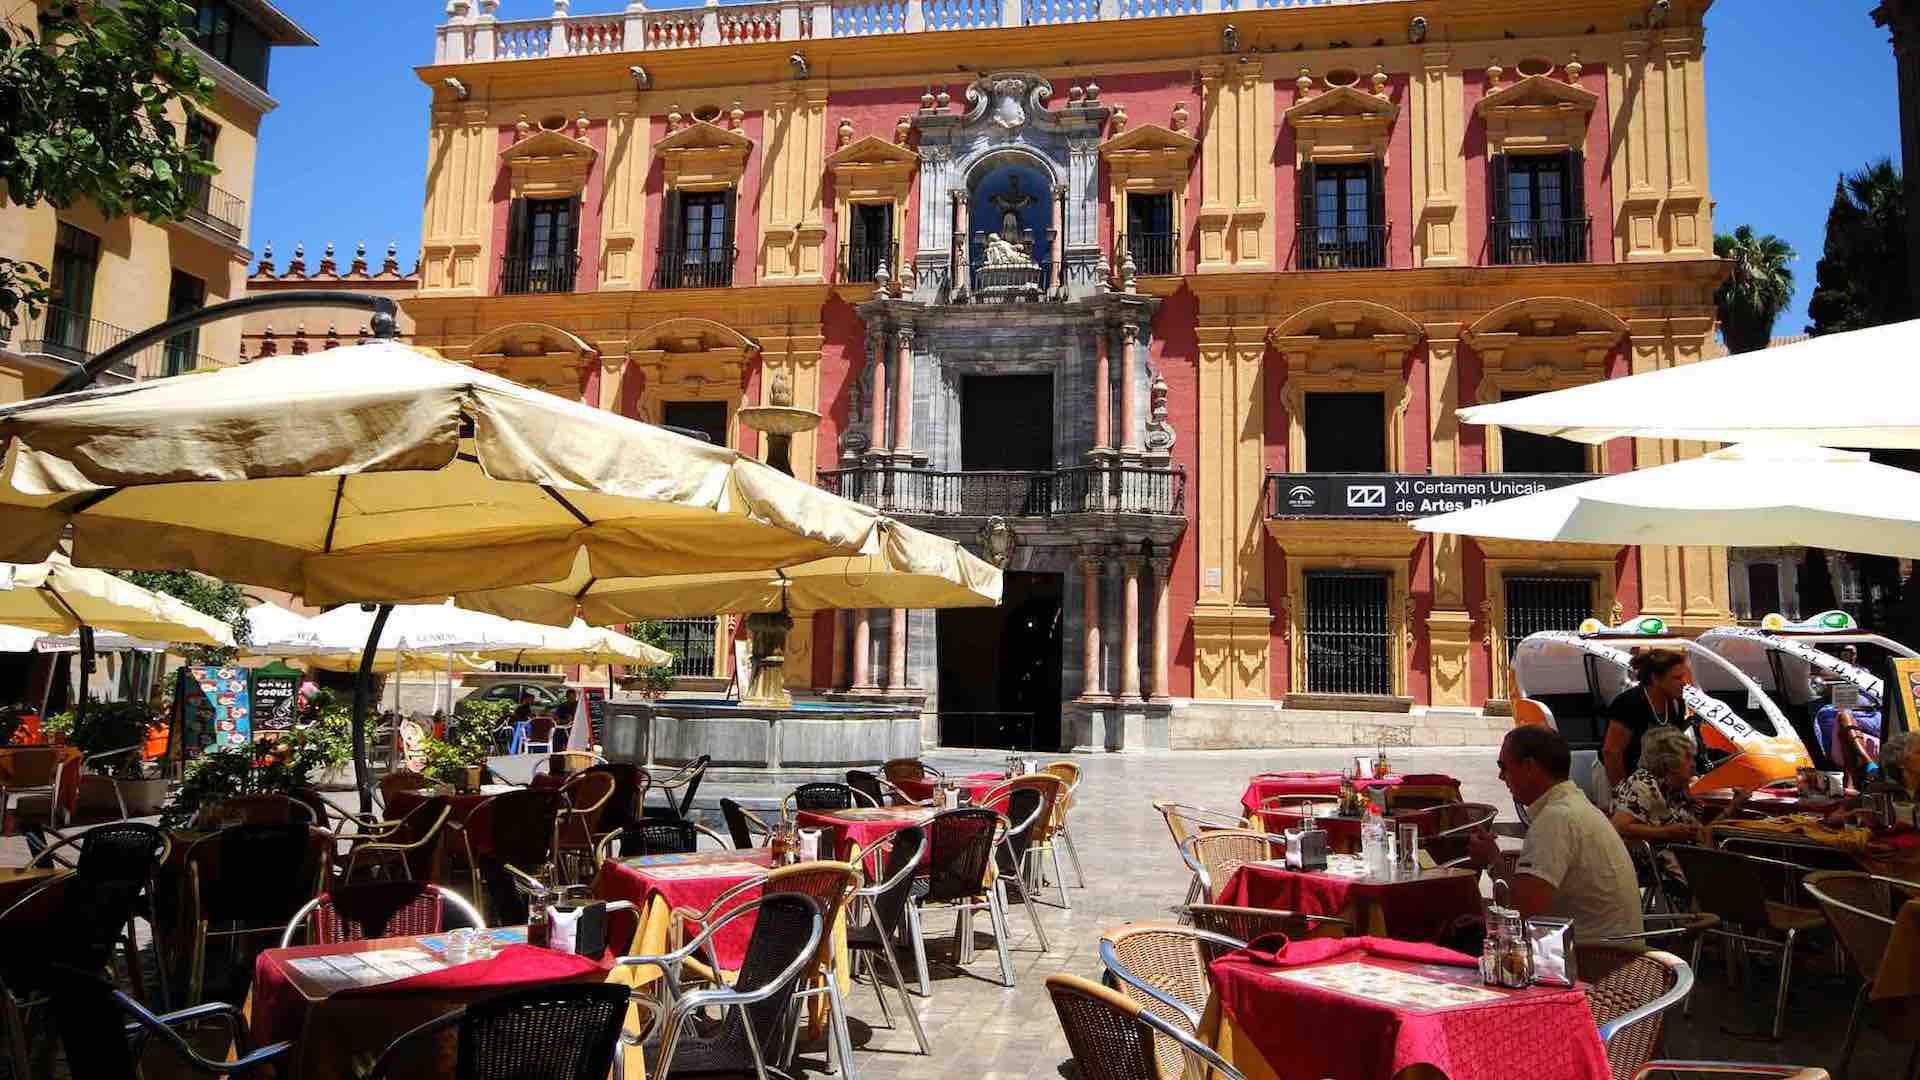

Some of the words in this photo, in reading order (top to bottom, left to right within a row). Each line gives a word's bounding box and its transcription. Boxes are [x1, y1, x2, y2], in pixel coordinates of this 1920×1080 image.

[1395, 481, 1409, 494] XI
[1413, 481, 1486, 494] Certamen
[1395, 499, 1415, 512] de
[1420, 499, 1464, 512] Artes
